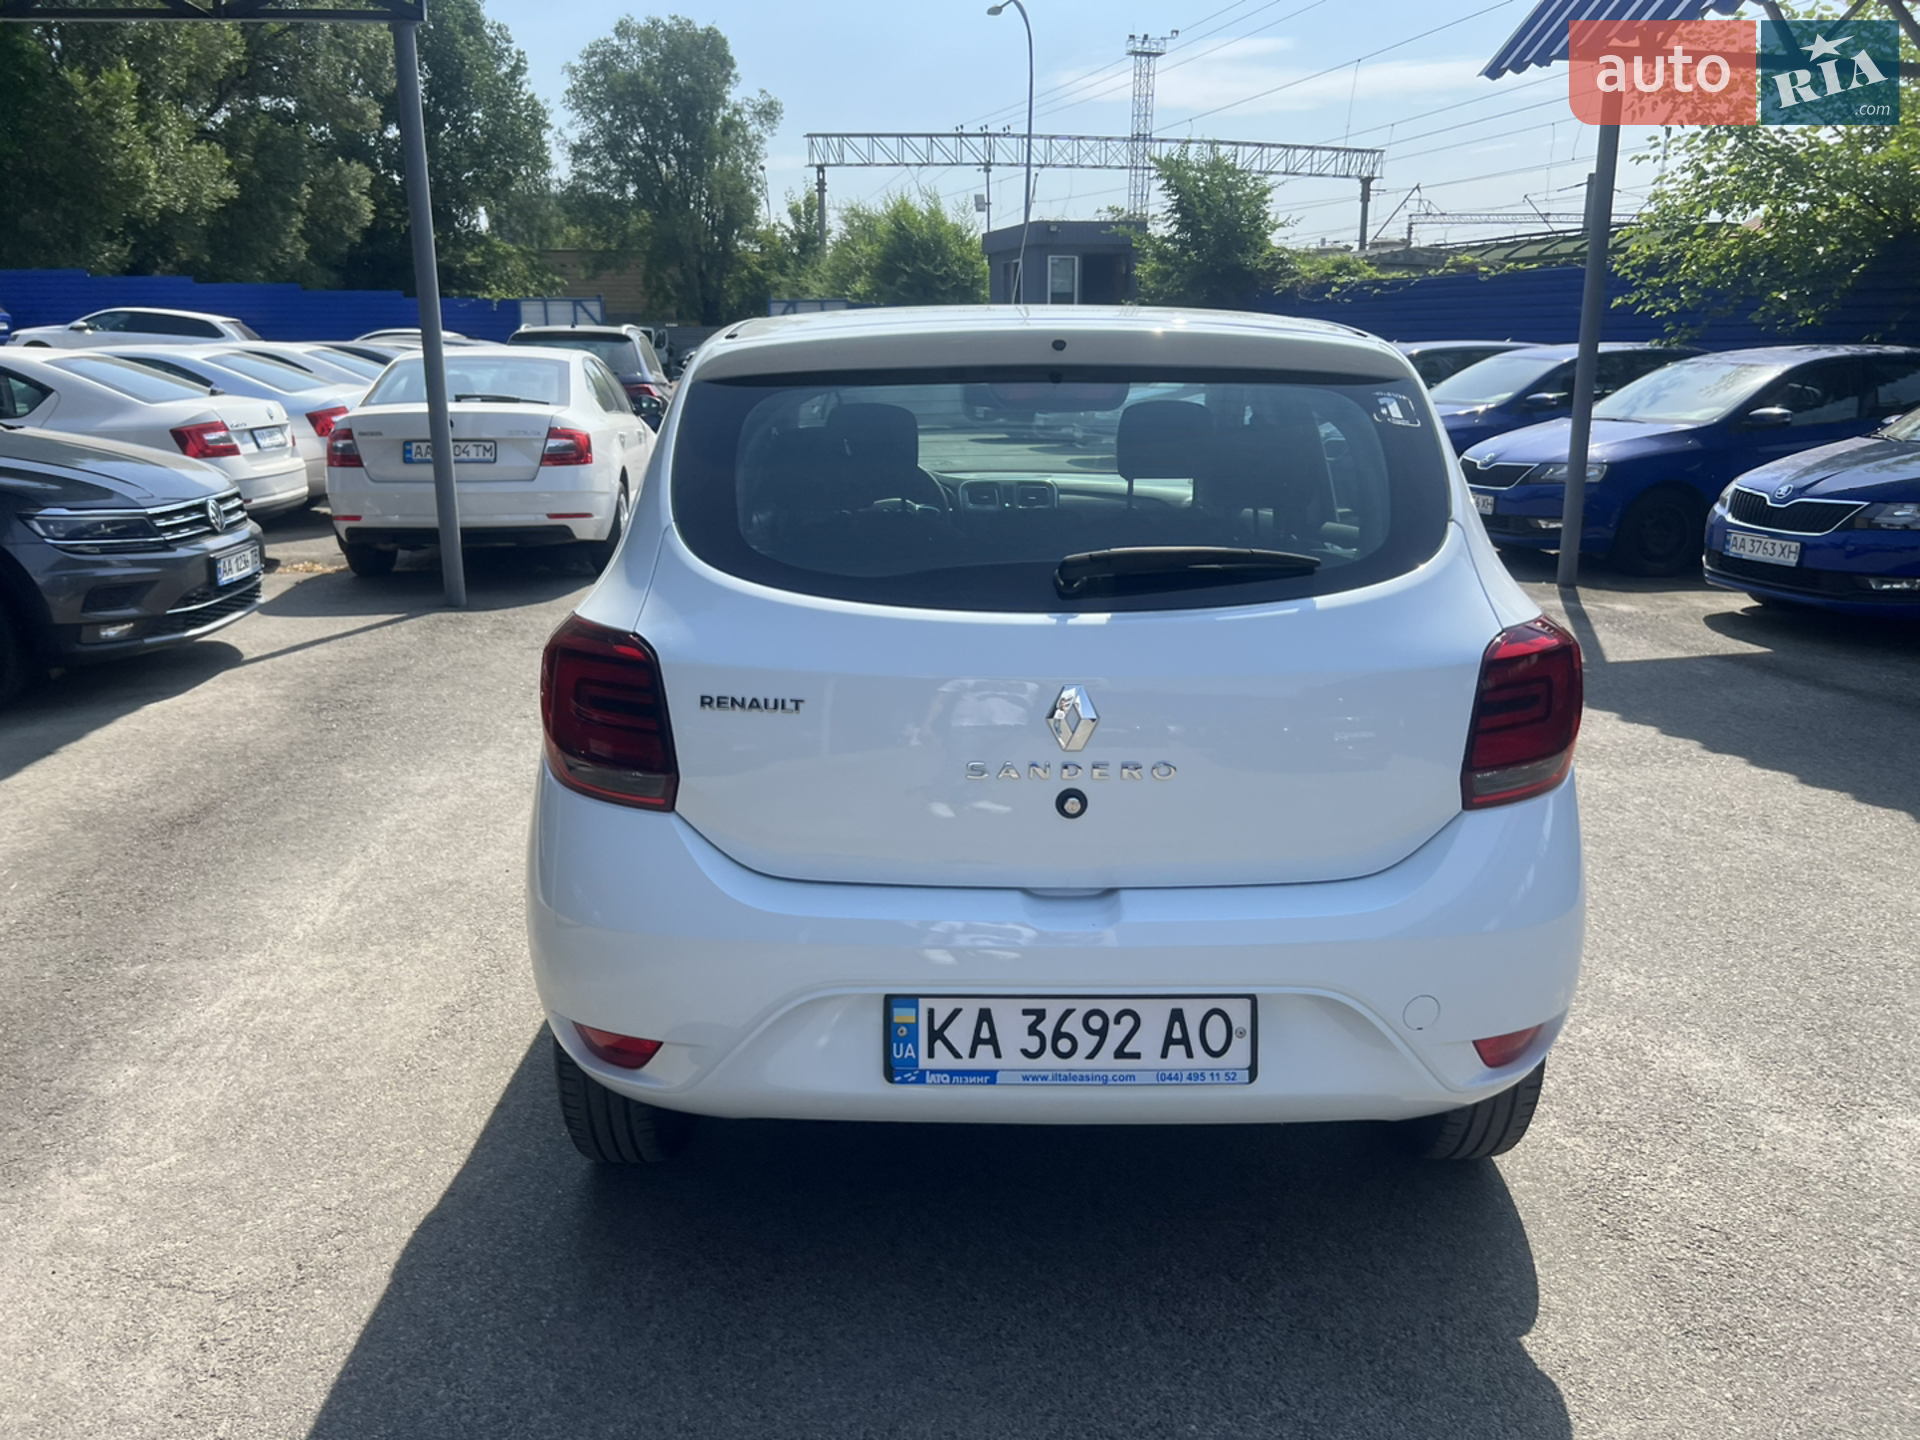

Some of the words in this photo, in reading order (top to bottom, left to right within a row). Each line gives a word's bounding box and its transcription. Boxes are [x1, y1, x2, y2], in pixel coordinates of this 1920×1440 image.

[472, 444, 493, 457] TM
[1731, 536, 1746, 552] AA
[1748, 539, 1777, 556] 3763
[1778, 543, 1799, 560] XH
[700, 695, 805, 714] RENAULT
[965, 760, 1178, 781] SANDERO
[926, 1007, 1002, 1060] KA
[1019, 1007, 1142, 1060] 3692
[1160, 1006, 1234, 1060] AO
[892, 1042, 917, 1059] UA
[1021, 1072, 1136, 1085] www.iltaleasing.com
[1156, 1071, 1184, 1083] (044)
[1186, 1071, 1206, 1082] 495
[1210, 1071, 1221, 1082] 11
[1224, 1071, 1238, 1082] 52
